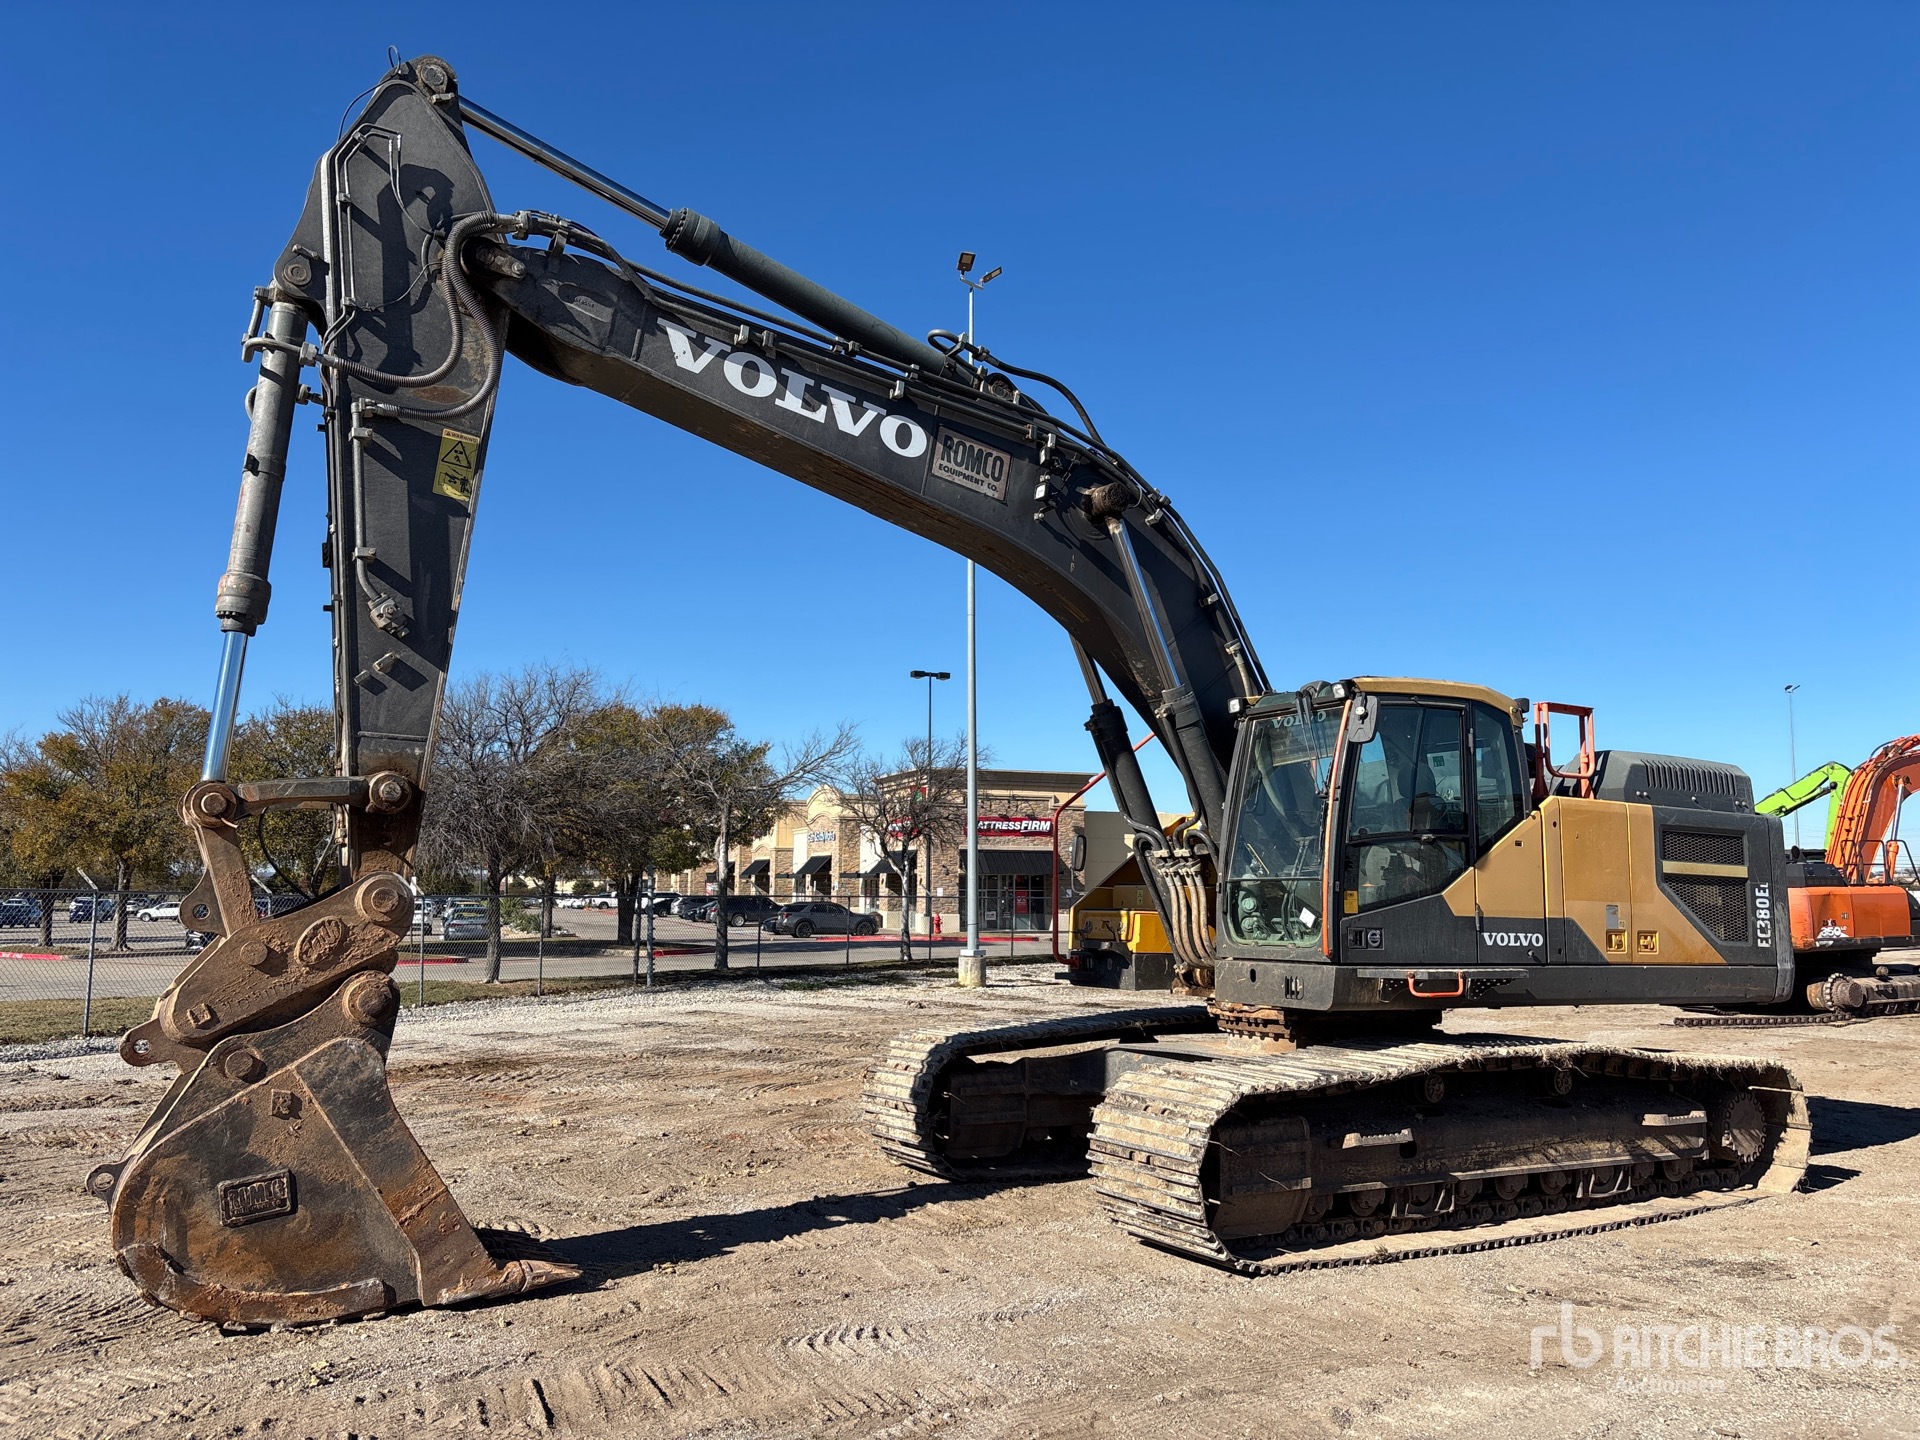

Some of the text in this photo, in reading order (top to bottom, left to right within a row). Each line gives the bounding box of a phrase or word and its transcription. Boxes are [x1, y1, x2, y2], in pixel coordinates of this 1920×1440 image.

[656, 317, 928, 458] VOLVO
[940, 434, 1005, 482] ROMCO
[938, 463, 999, 493] EQUIPMENT CO.
[1481, 932, 1544, 947] VOLVO
